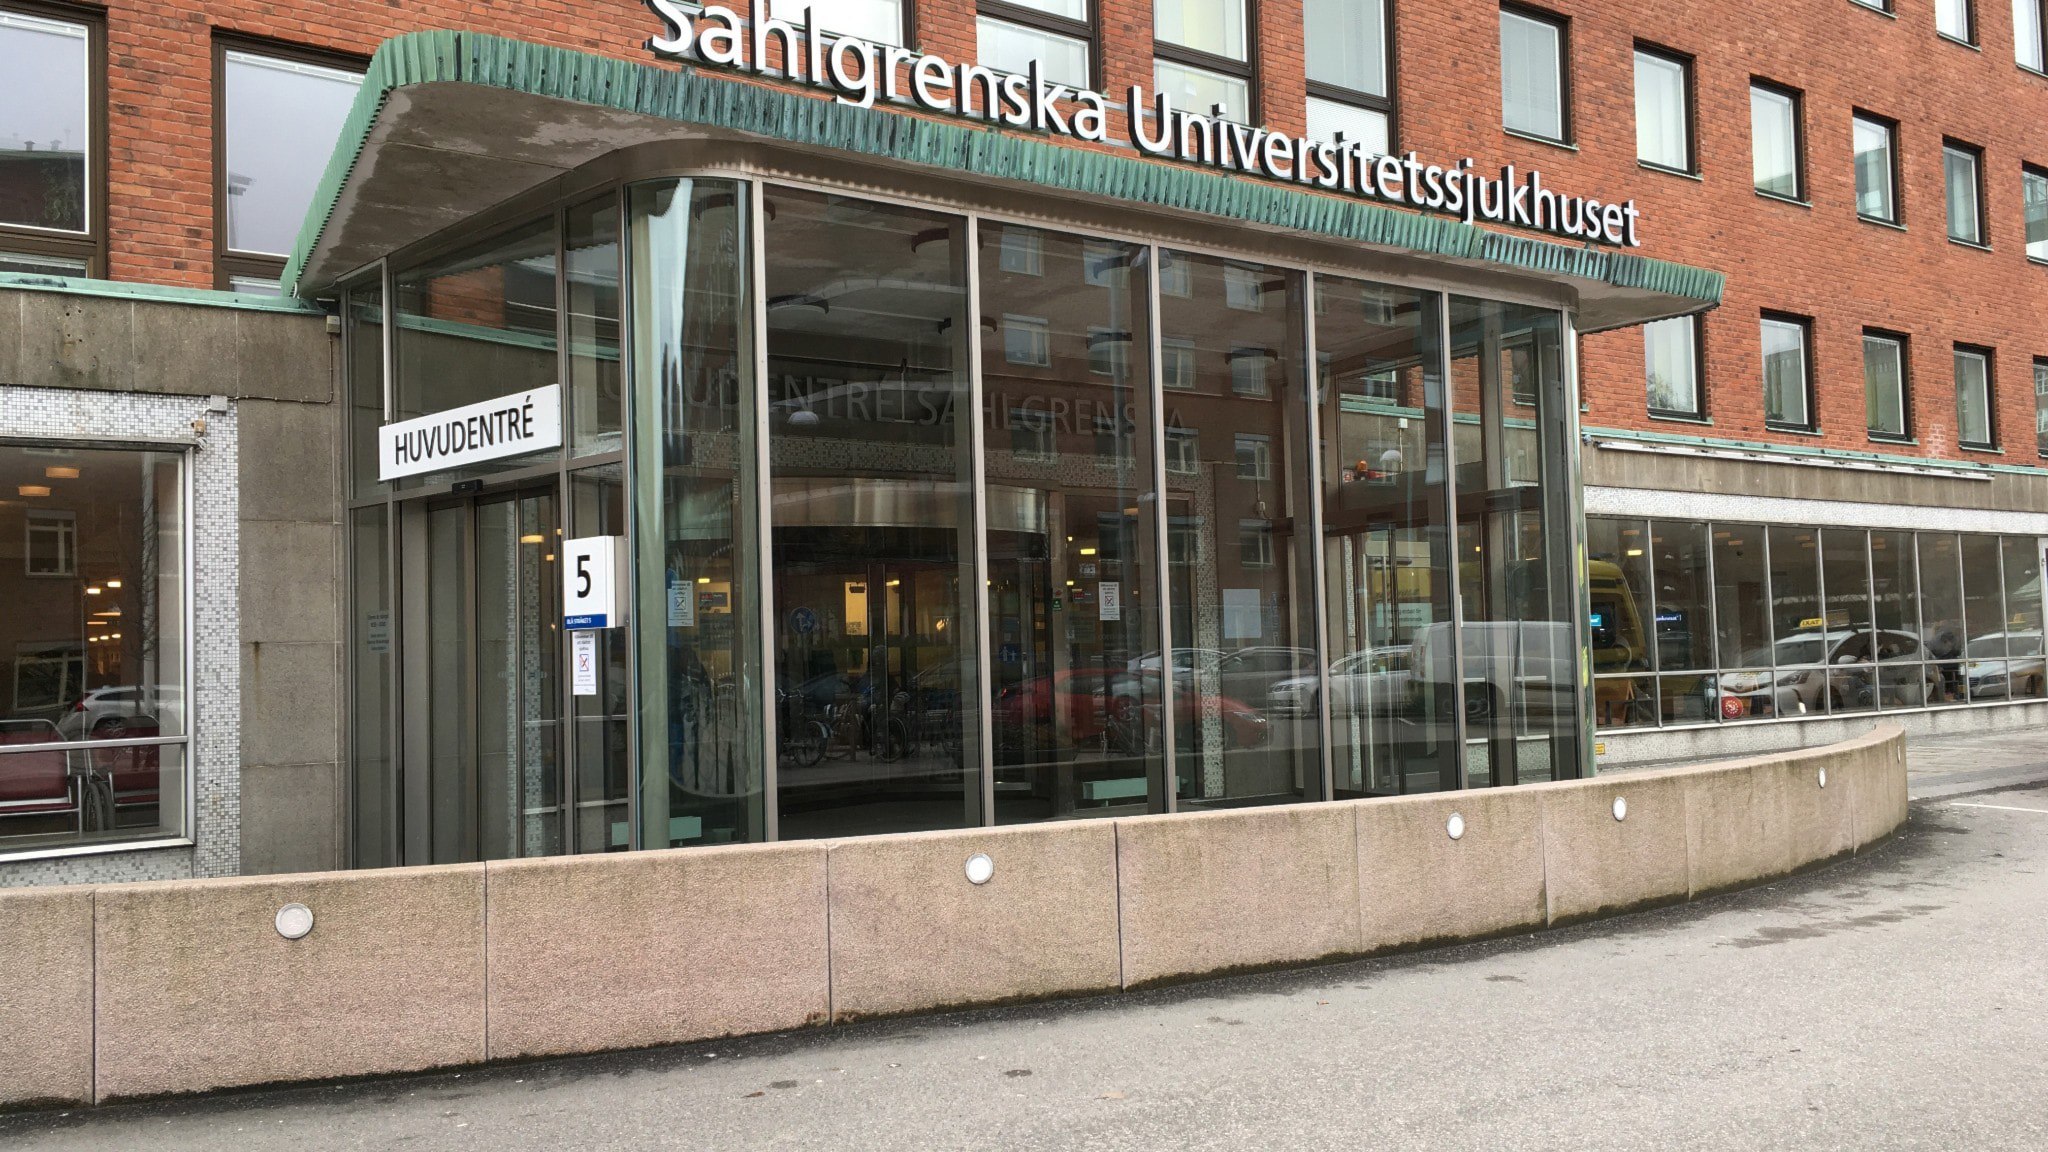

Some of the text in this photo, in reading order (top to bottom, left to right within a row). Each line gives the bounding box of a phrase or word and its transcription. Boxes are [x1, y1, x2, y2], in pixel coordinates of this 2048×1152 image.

[647, 0, 1641, 247] Sahlgrenska Universitetssjukhuset
[394, 395, 535, 465] HUVUDENTRÉ
[576, 554, 592, 598] 5
